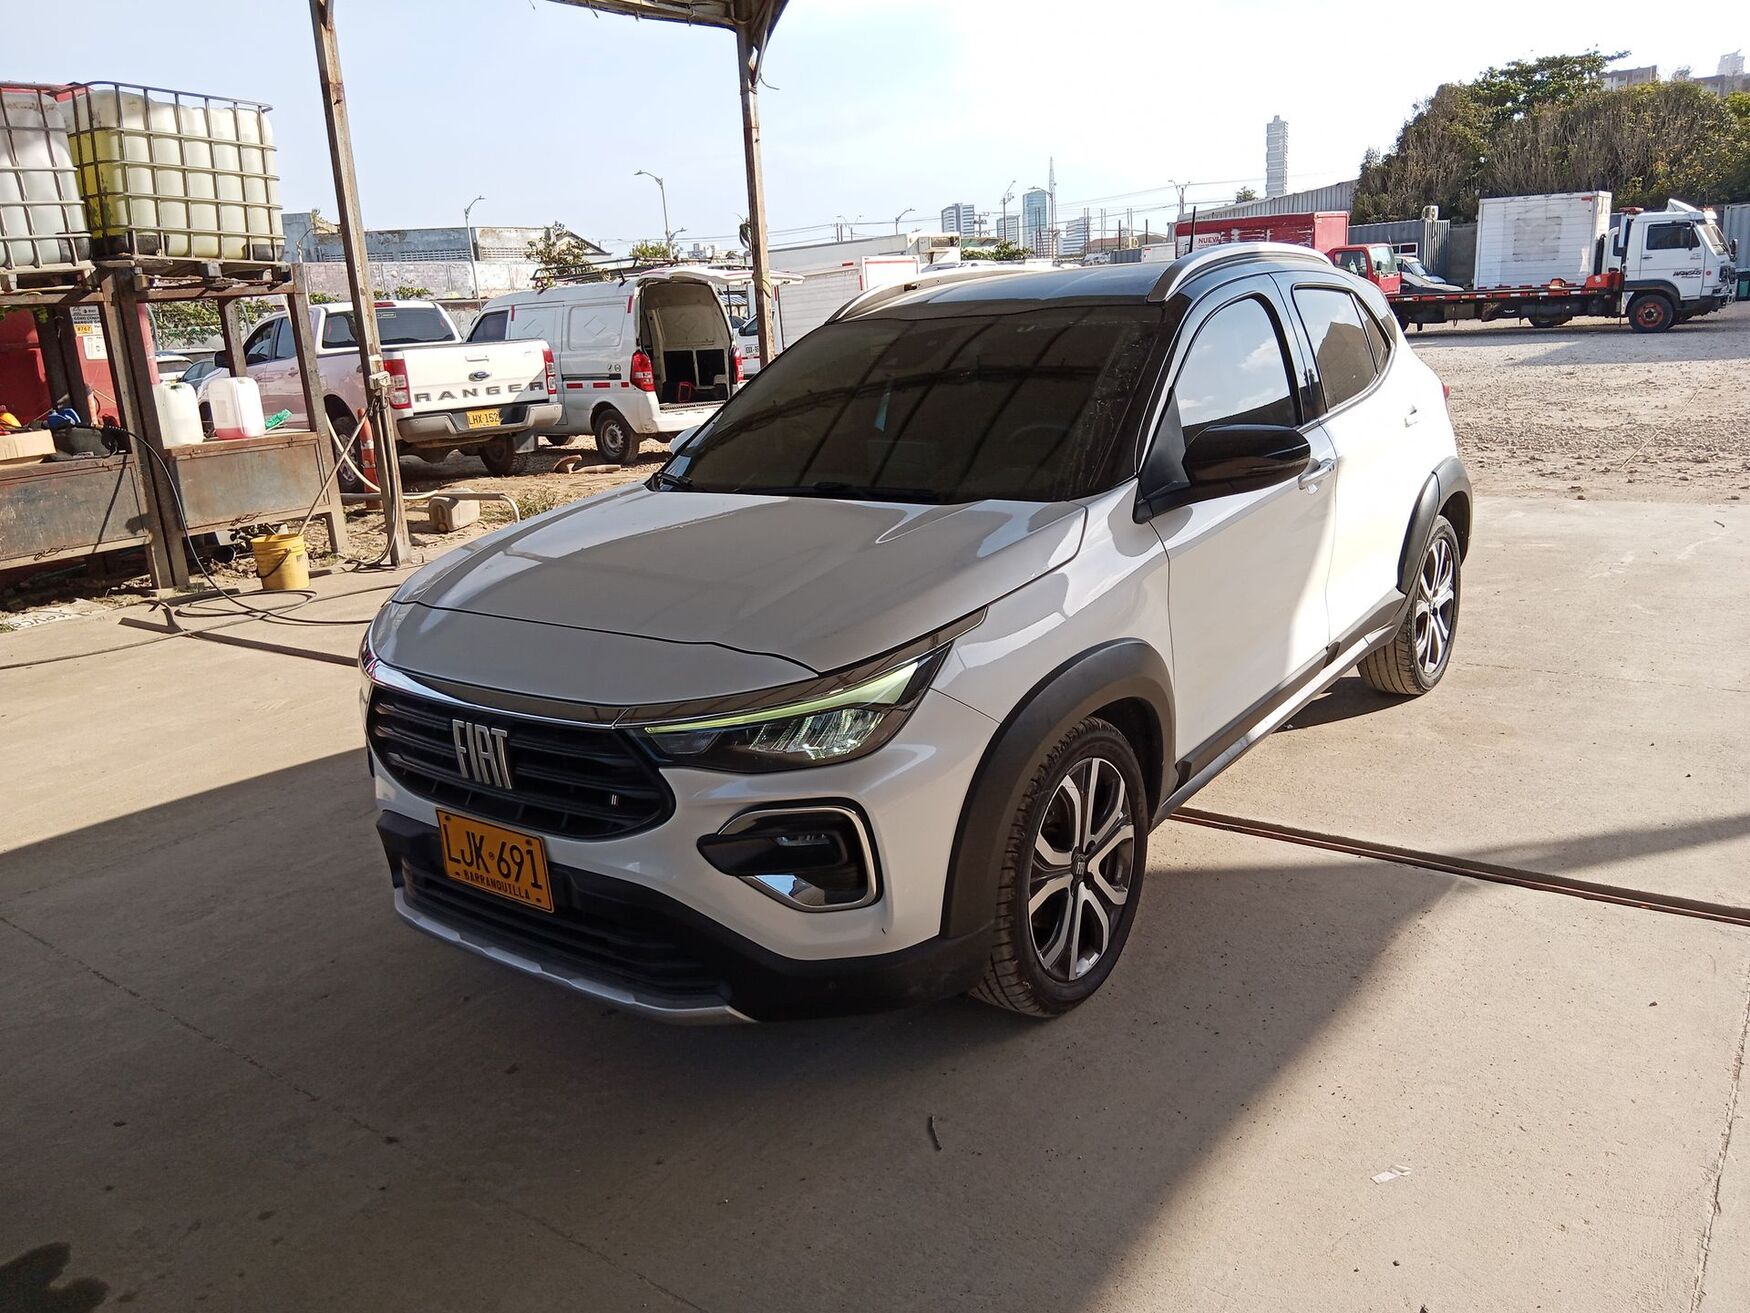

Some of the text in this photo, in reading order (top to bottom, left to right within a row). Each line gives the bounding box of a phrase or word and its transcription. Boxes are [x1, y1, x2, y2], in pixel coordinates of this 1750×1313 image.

[413, 381, 544, 403] RANGER
[452, 719, 513, 790] FIAT
[463, 869, 531, 900] BARRANQUILLA
